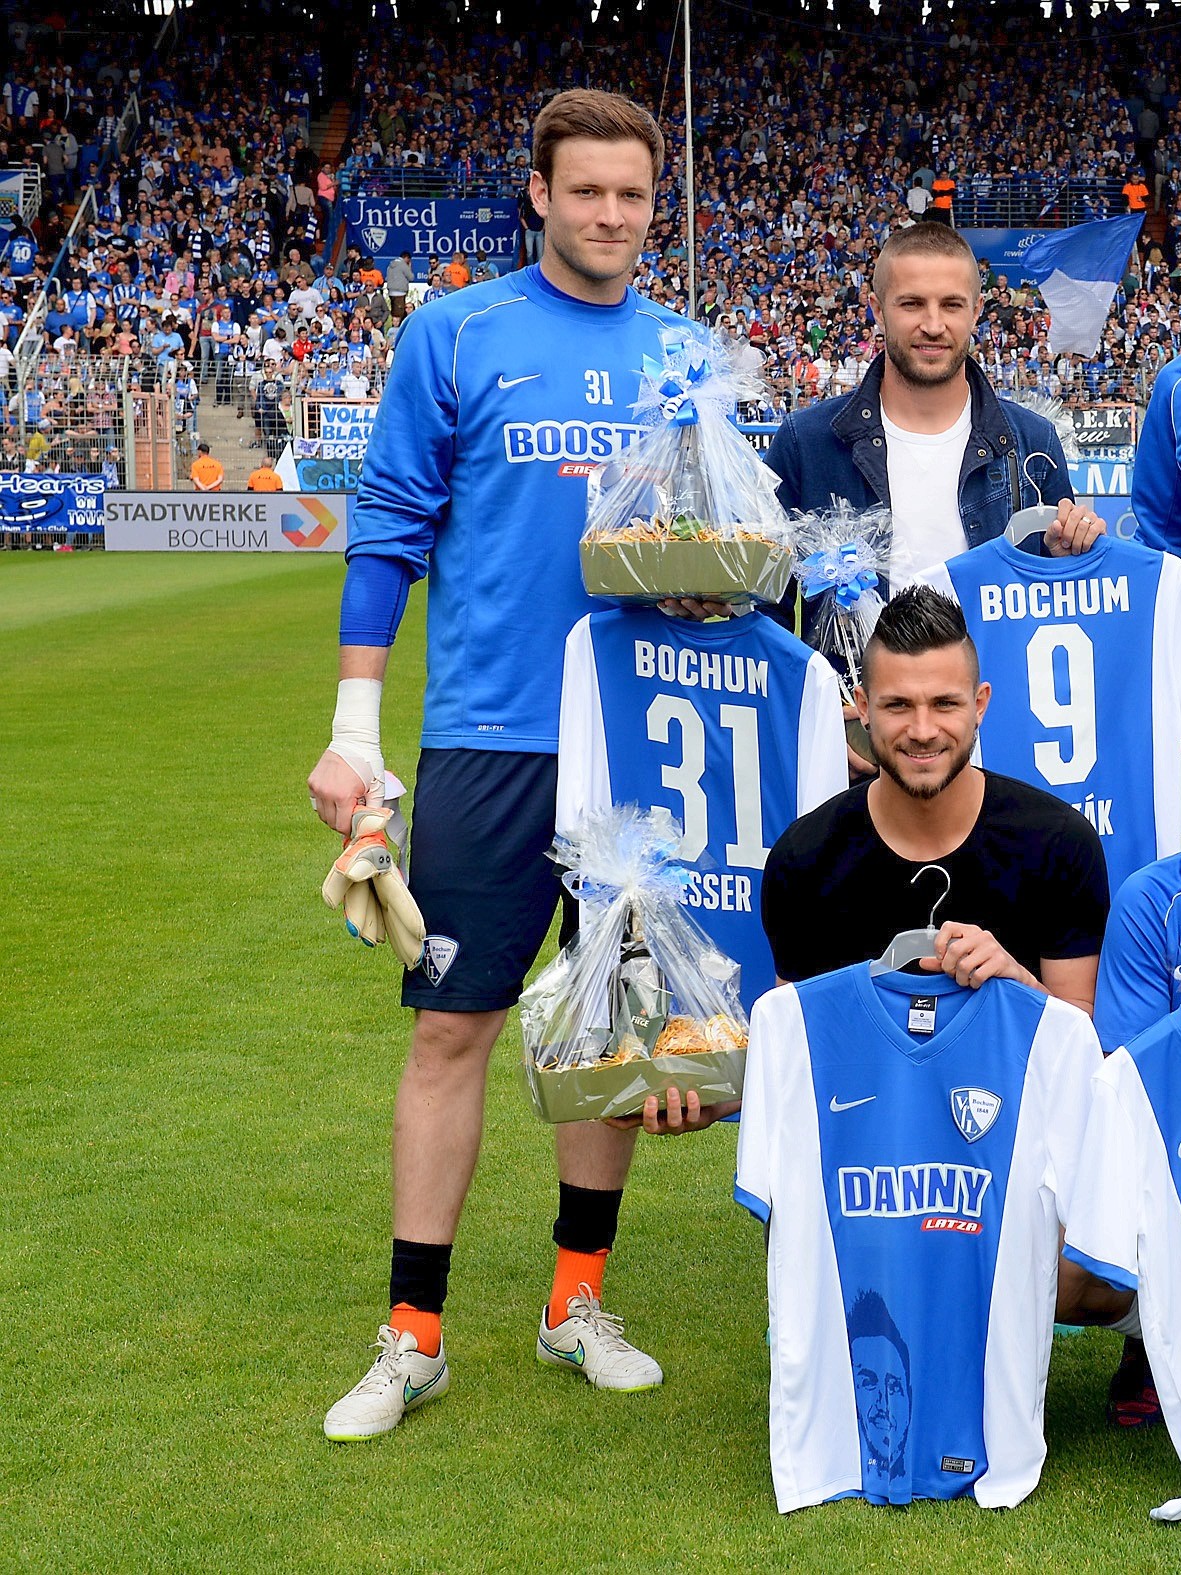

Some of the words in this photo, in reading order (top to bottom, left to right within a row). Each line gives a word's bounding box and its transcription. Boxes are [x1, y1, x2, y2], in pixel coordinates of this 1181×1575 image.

[584, 369, 614, 406] 31
[505, 421, 648, 462] BOOST
[0, 475, 104, 494] Hearts
[76, 496, 96, 509] ON
[106, 503, 267, 522] STADTWERKE
[168, 530, 268, 547] BOCHUM
[980, 575, 1130, 622] BOCHUM
[634, 639, 769, 698] BOCHUM
[1026, 623, 1098, 786] 9
[646, 693, 772, 870] 31
[840, 1165, 991, 1215] DANNY
[926, 1218, 978, 1232] LATZA
